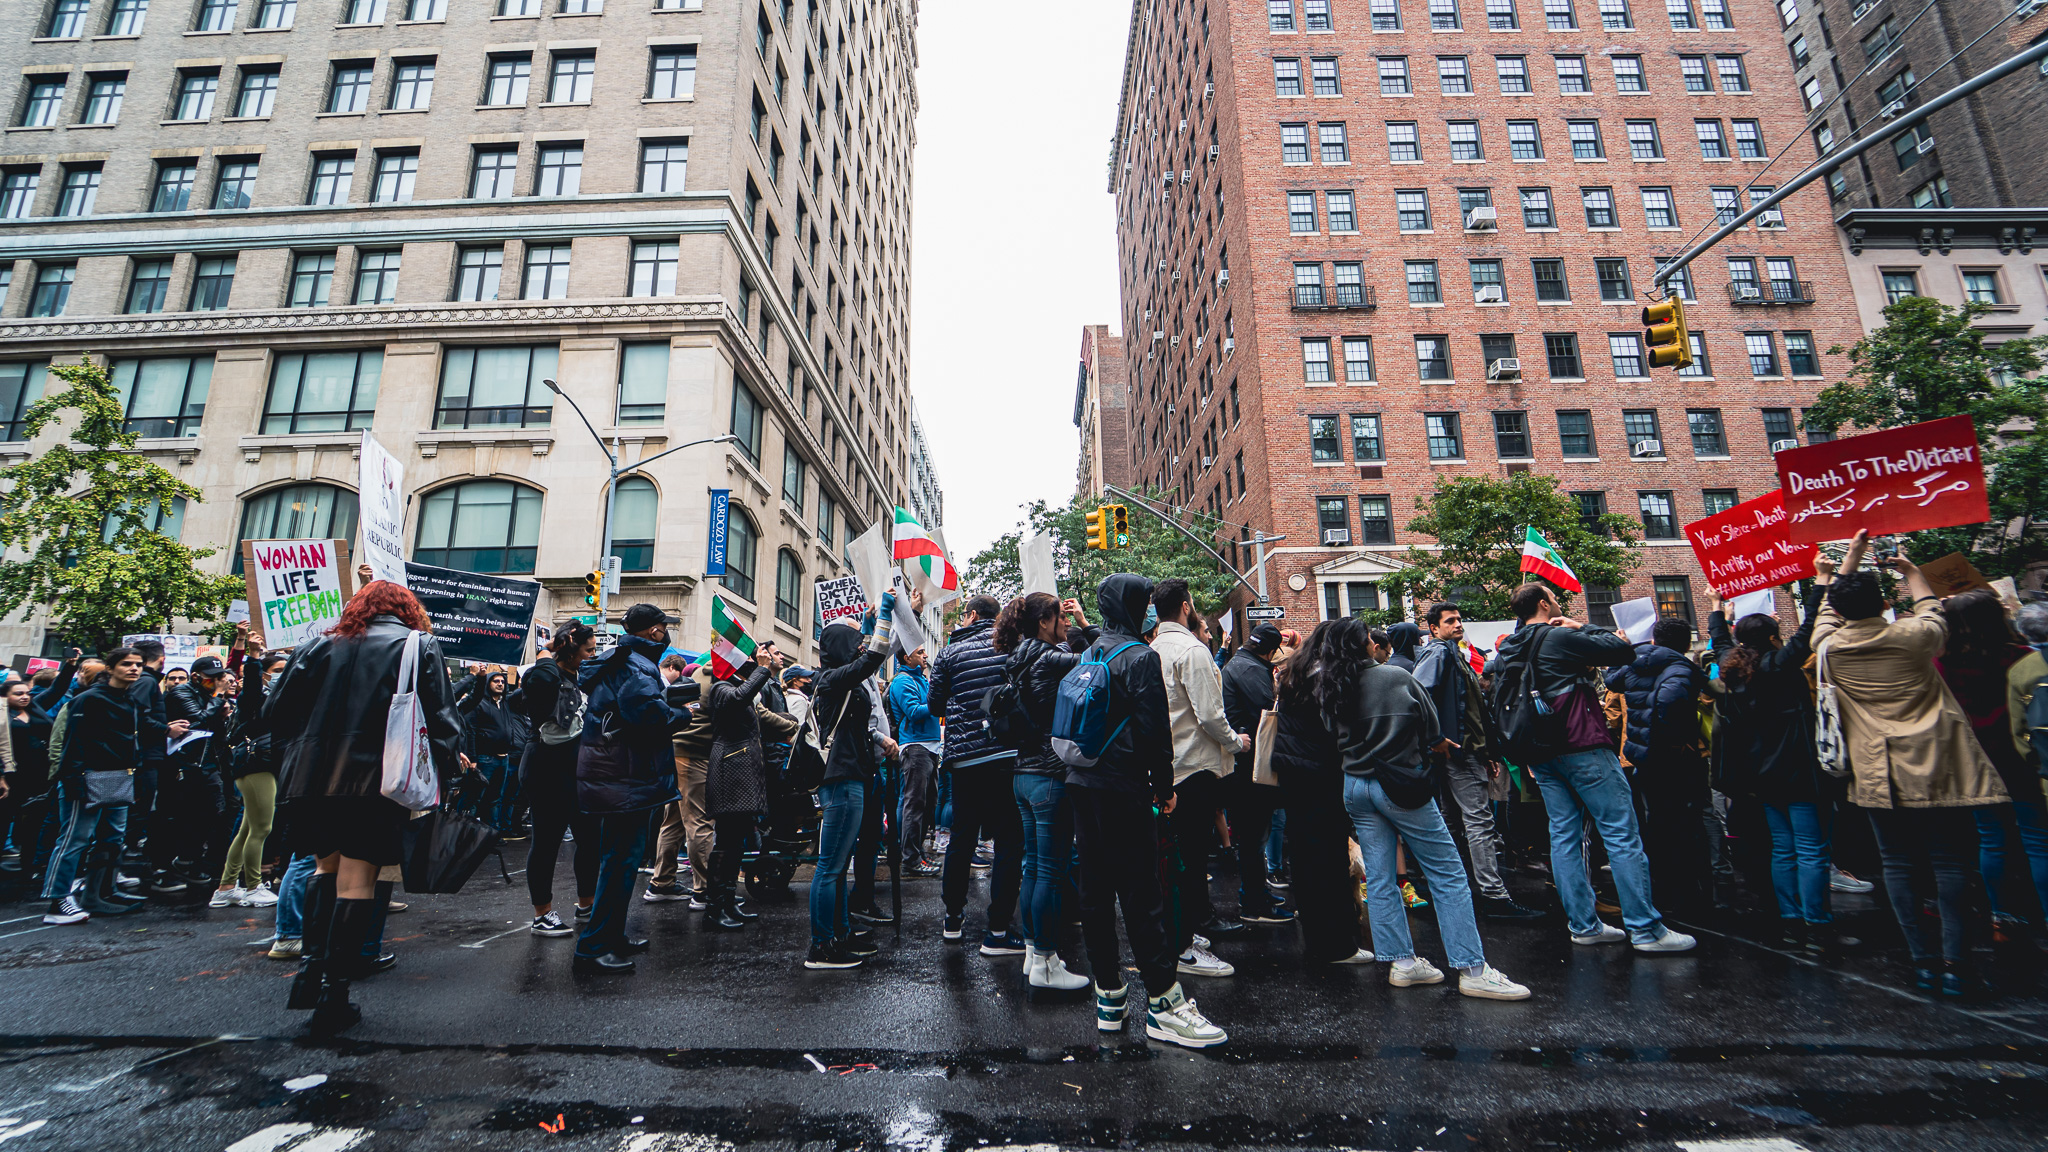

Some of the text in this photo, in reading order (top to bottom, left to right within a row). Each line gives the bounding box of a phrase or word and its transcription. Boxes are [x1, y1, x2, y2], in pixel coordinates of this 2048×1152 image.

[1788, 470, 1844, 495] Death
[1840, 460, 1869, 482] To
[1897, 470, 1970, 507] مرگ
[1862, 493, 1889, 512] بر
[367, 507, 399, 539] ISLAMIC
[714, 495, 726, 565] CARDOZO LAW
[1694, 530, 1722, 549] Your
[1753, 505, 1787, 528] Death
[256, 543, 327, 571] WOMAN
[366, 527, 403, 562] REPUBLIC
[1709, 554, 1755, 579] Amplify
[1755, 548, 1774, 564] our
[272, 570, 320, 597] LIFE
[406, 572, 531, 597] iggest war for feminism and human
[820, 576, 857, 592] WHEN
[1716, 562, 1803, 596] #MAHSA AMINI
[264, 589, 341, 630] FREEDOM
[417, 585, 455, 598] happening
[456, 591, 465, 599] in
[465, 593, 489, 603] IRAN,
[489, 597, 506, 606] right
[821, 601, 831, 610] IS
[833, 599, 844, 608] A
[434, 612, 453, 620] earth
[462, 616, 485, 625] you're
[485, 619, 506, 628] being
[506, 621, 528, 631] silent,
[822, 602, 867, 620] REVOLU
[431, 622, 521, 641] alk about WOMAN rights
